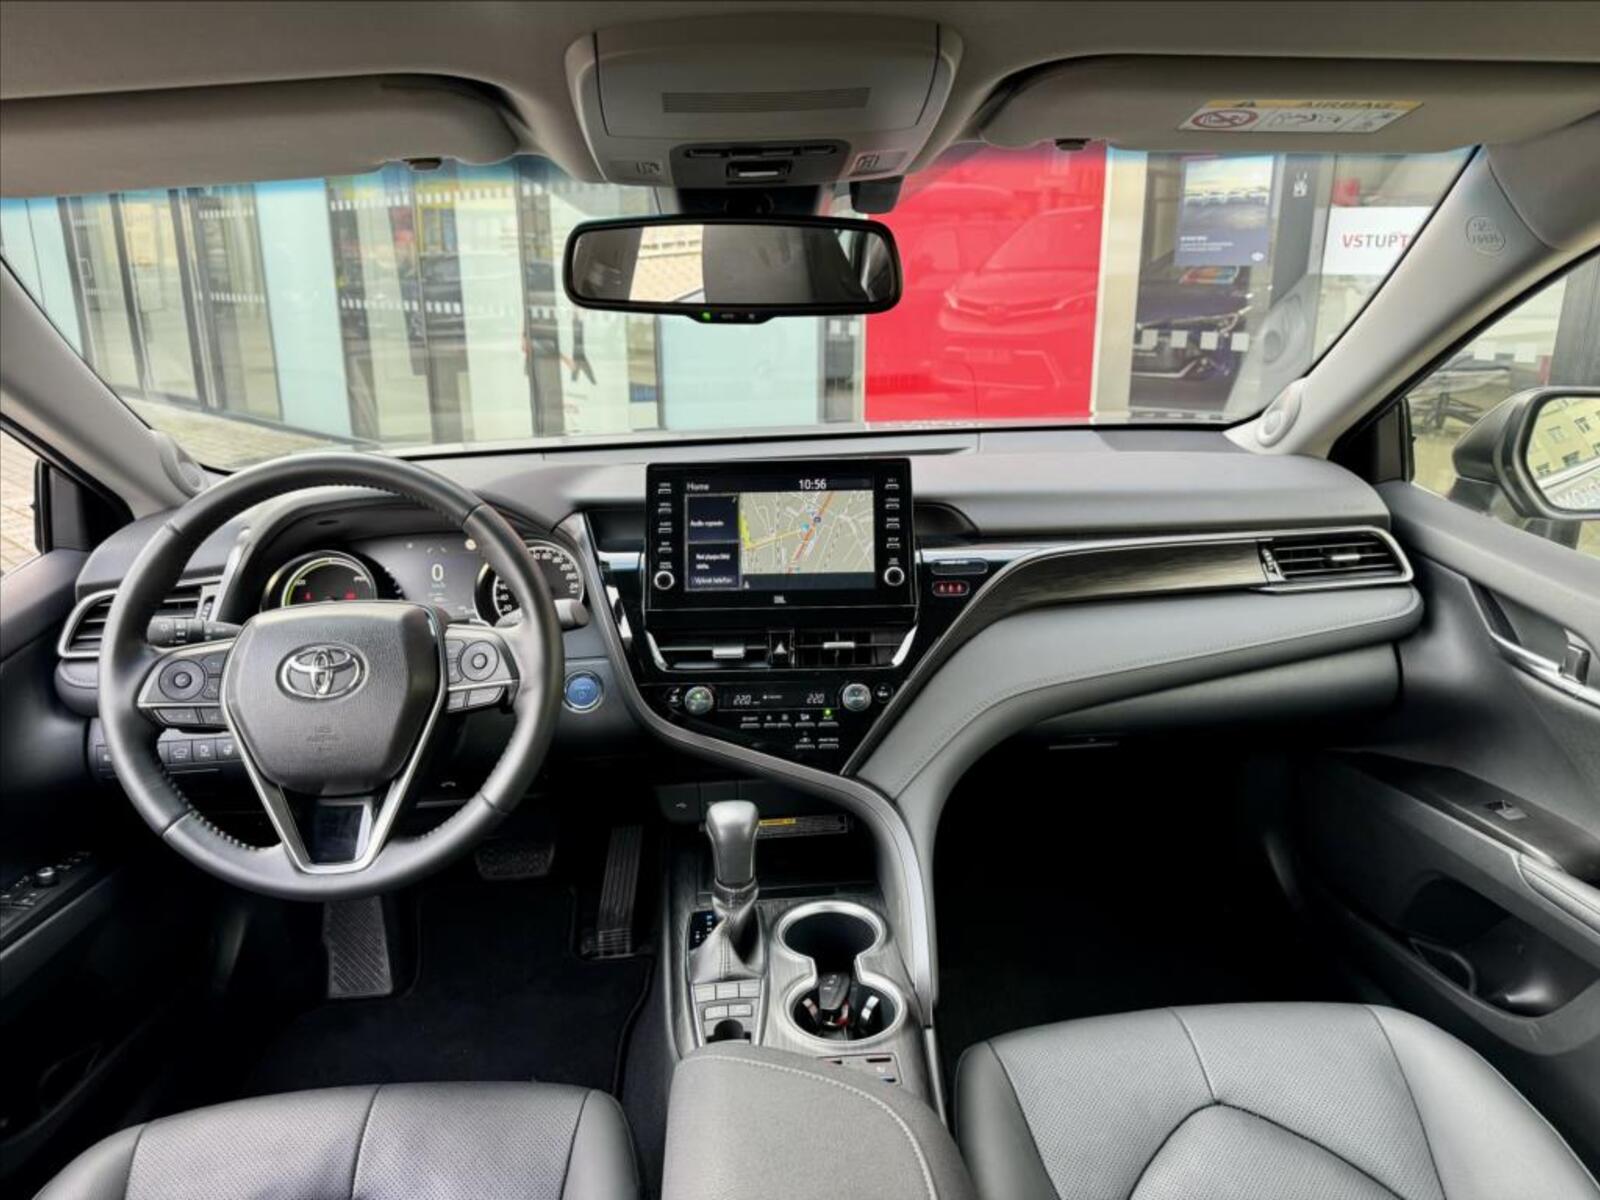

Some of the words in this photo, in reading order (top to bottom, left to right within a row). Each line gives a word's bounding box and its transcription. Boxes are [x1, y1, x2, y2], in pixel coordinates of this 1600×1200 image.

[1342, 233, 1412, 248] VSTUPT
[686, 481, 710, 492] Home
[799, 479, 827, 491] 10:56
[431, 563, 445, 582] 0
